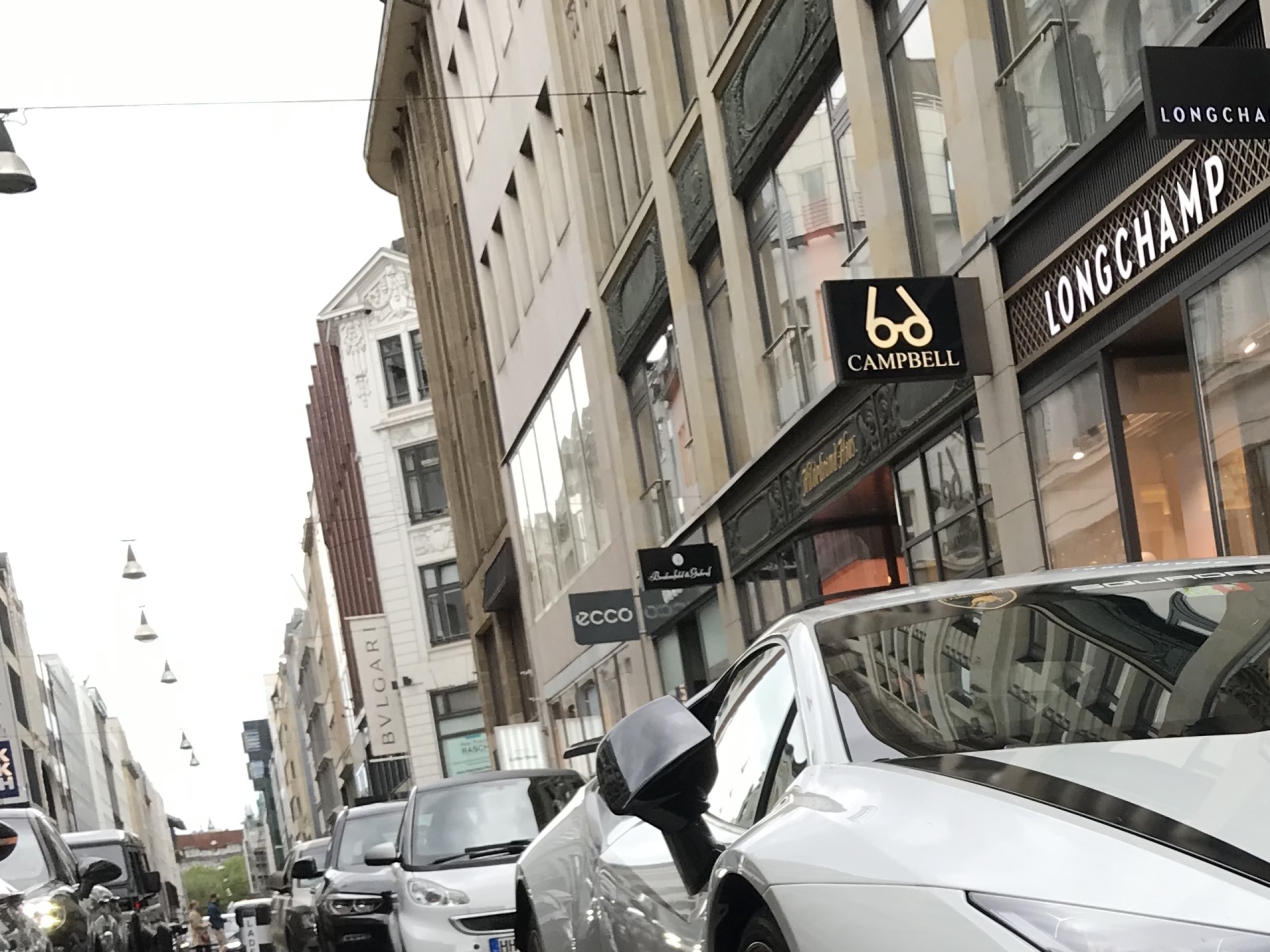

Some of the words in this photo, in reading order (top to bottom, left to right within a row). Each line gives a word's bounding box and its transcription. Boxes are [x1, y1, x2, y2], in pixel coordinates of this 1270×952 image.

[1044, 154, 1225, 336] LONGCHAMP
[847, 349, 960, 371] CAMPBELL
[575, 607, 633, 626] ecco
[363, 627, 396, 746] BVLGARI
